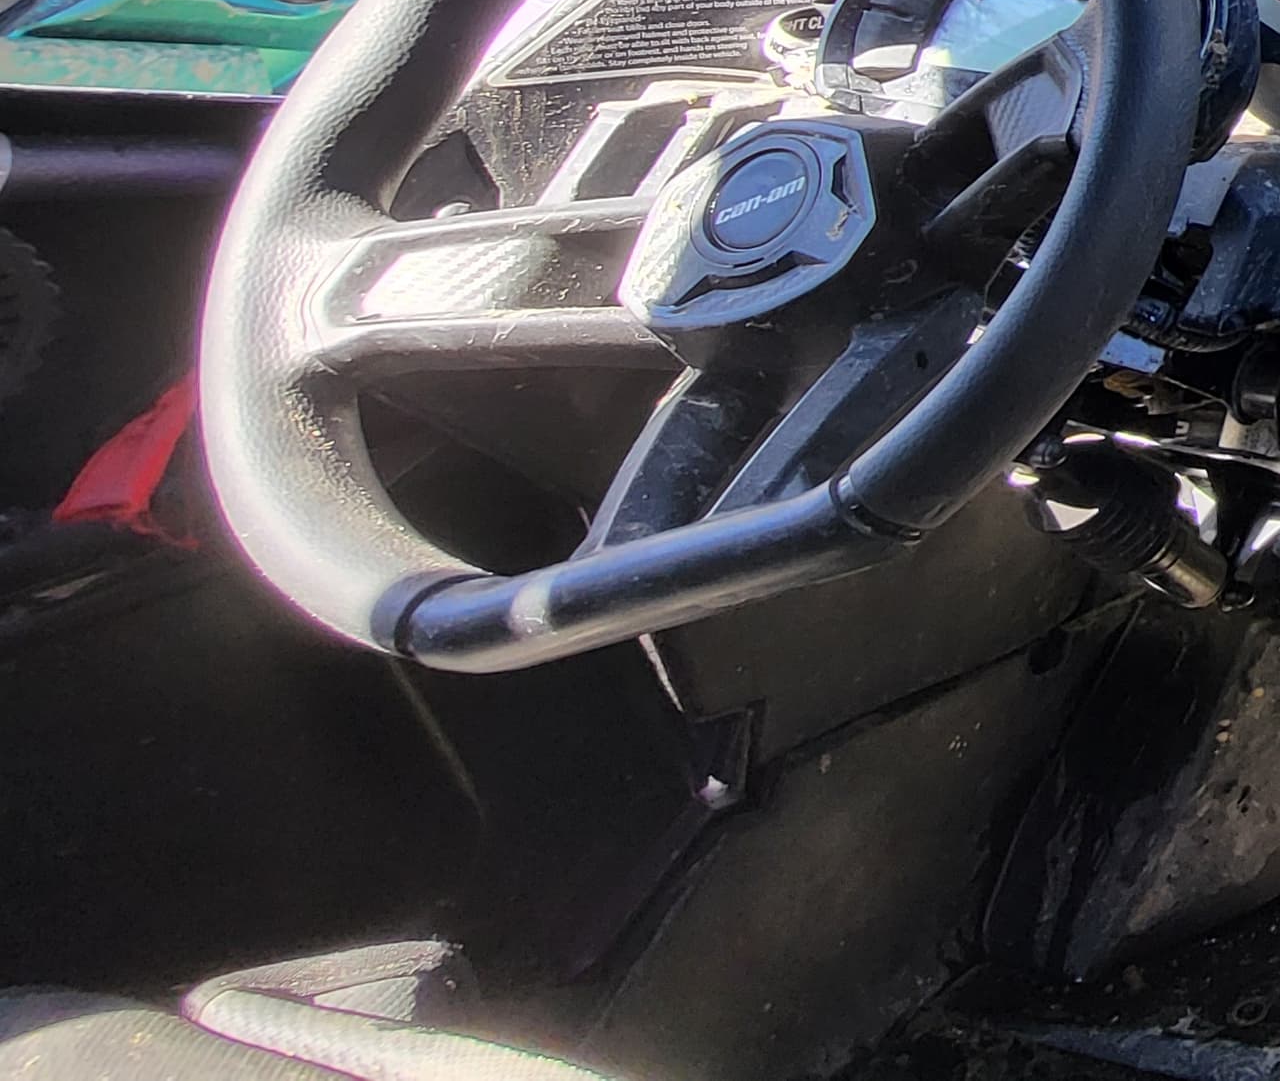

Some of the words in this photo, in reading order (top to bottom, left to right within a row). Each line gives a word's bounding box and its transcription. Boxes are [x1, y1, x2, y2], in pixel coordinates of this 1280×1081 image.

[714, 0, 735, 10] body
[808, 15, 824, 30] CL
[714, 175, 806, 226] can-am
